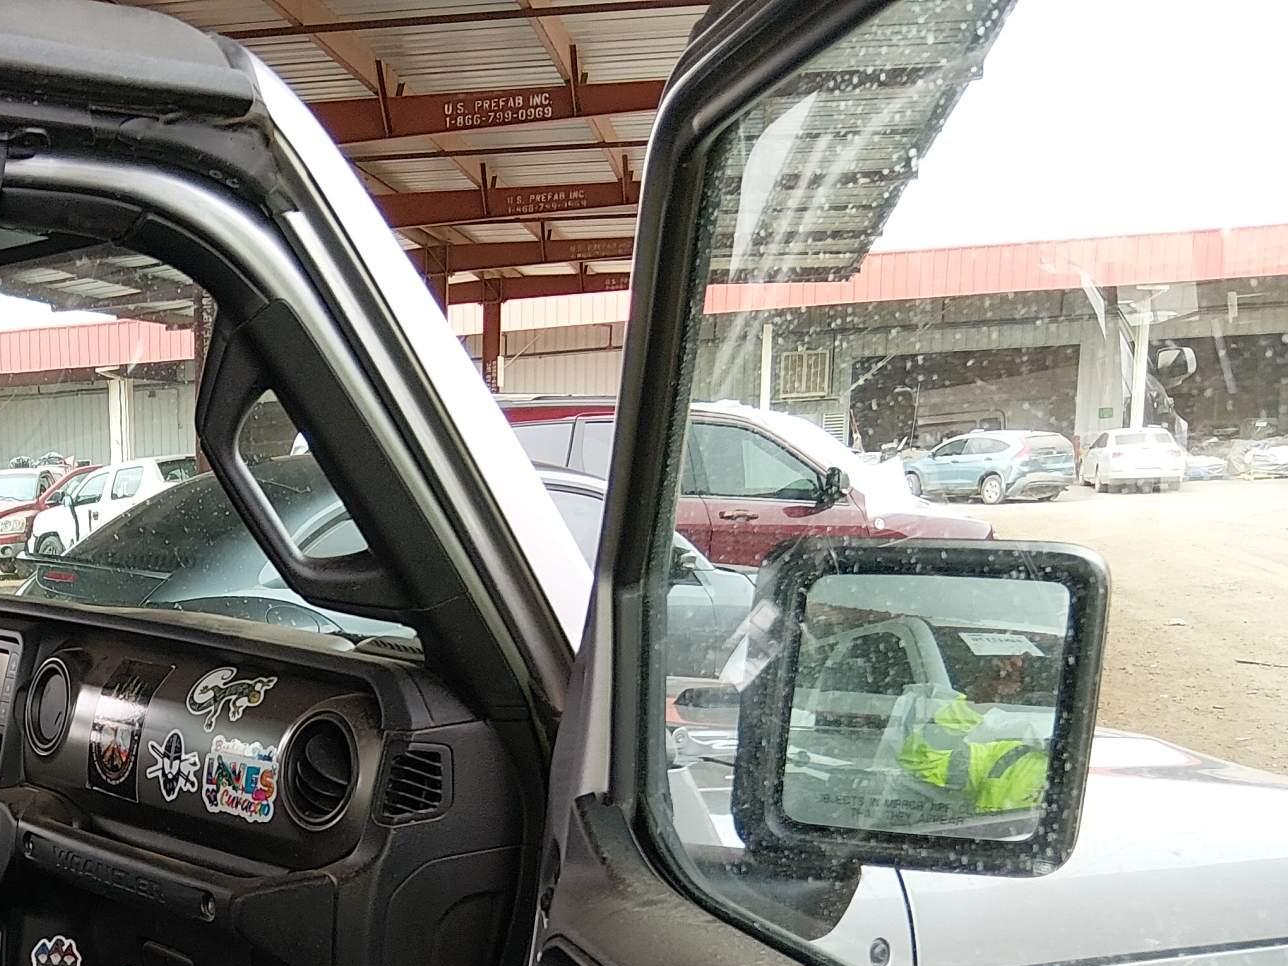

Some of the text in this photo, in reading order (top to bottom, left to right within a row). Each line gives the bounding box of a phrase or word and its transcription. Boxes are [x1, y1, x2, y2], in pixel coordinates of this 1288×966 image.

[444, 93, 553, 115] U.S. PREFAB INC.
[445, 106, 553, 128] 1-866-799-0969
[529, 191, 565, 203] PREFAB
